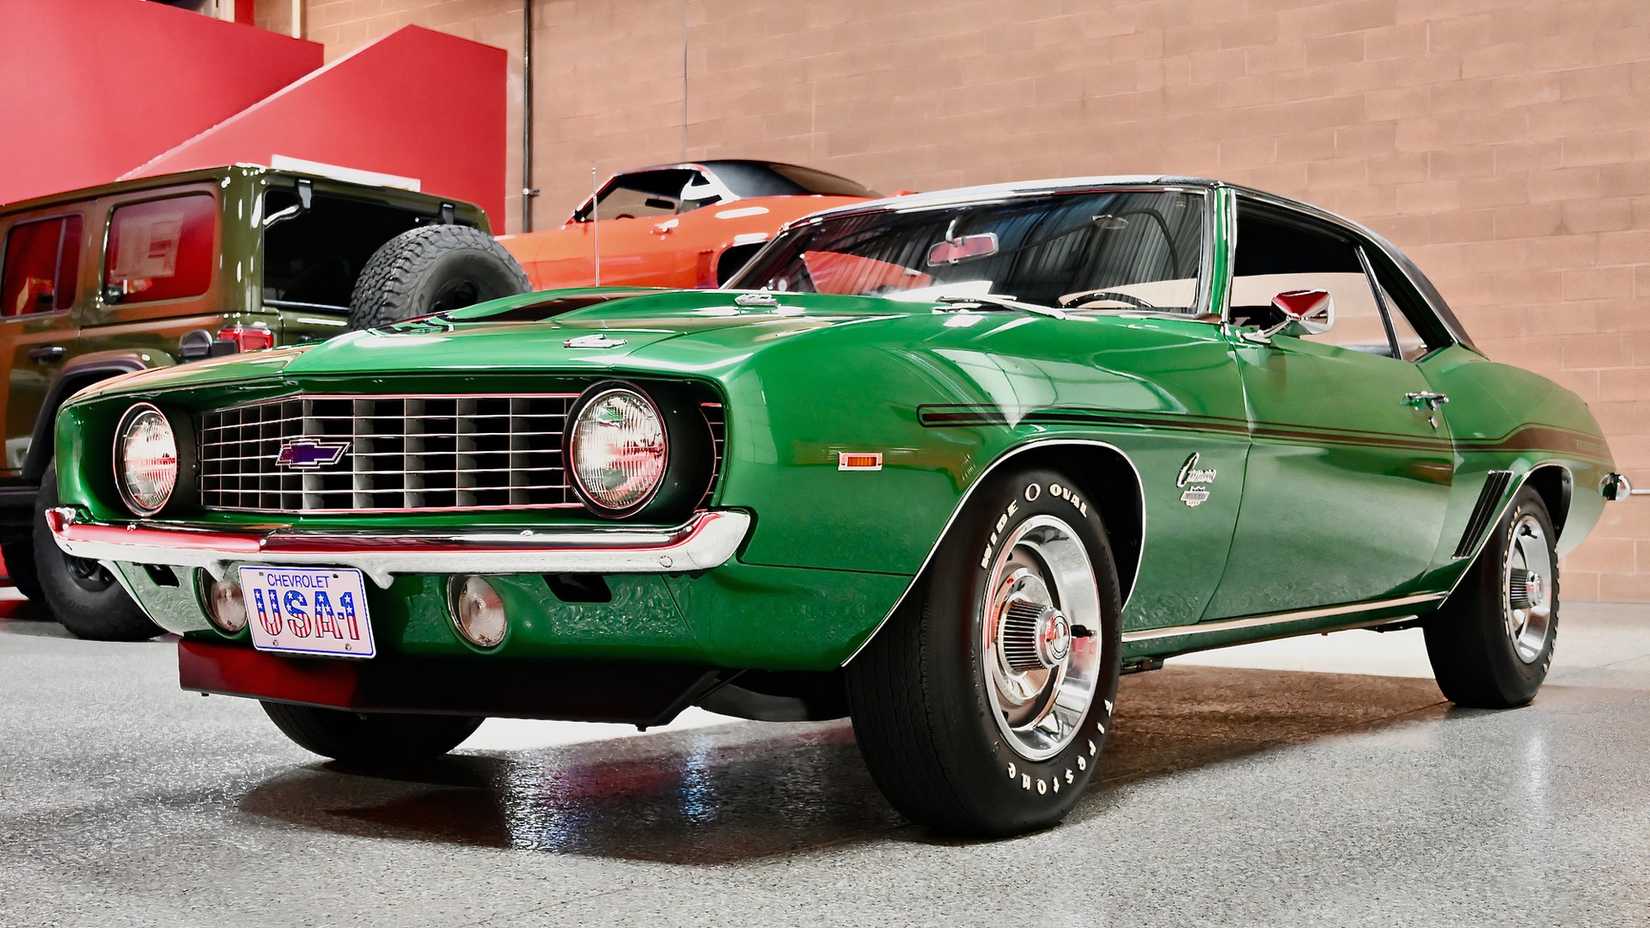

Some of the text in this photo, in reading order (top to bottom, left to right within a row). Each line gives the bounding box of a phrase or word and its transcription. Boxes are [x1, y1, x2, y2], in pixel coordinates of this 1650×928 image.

[980, 500, 1019, 569] WIDE
[1049, 483, 1088, 518] OVAL
[267, 573, 330, 588] CHEVROLET
